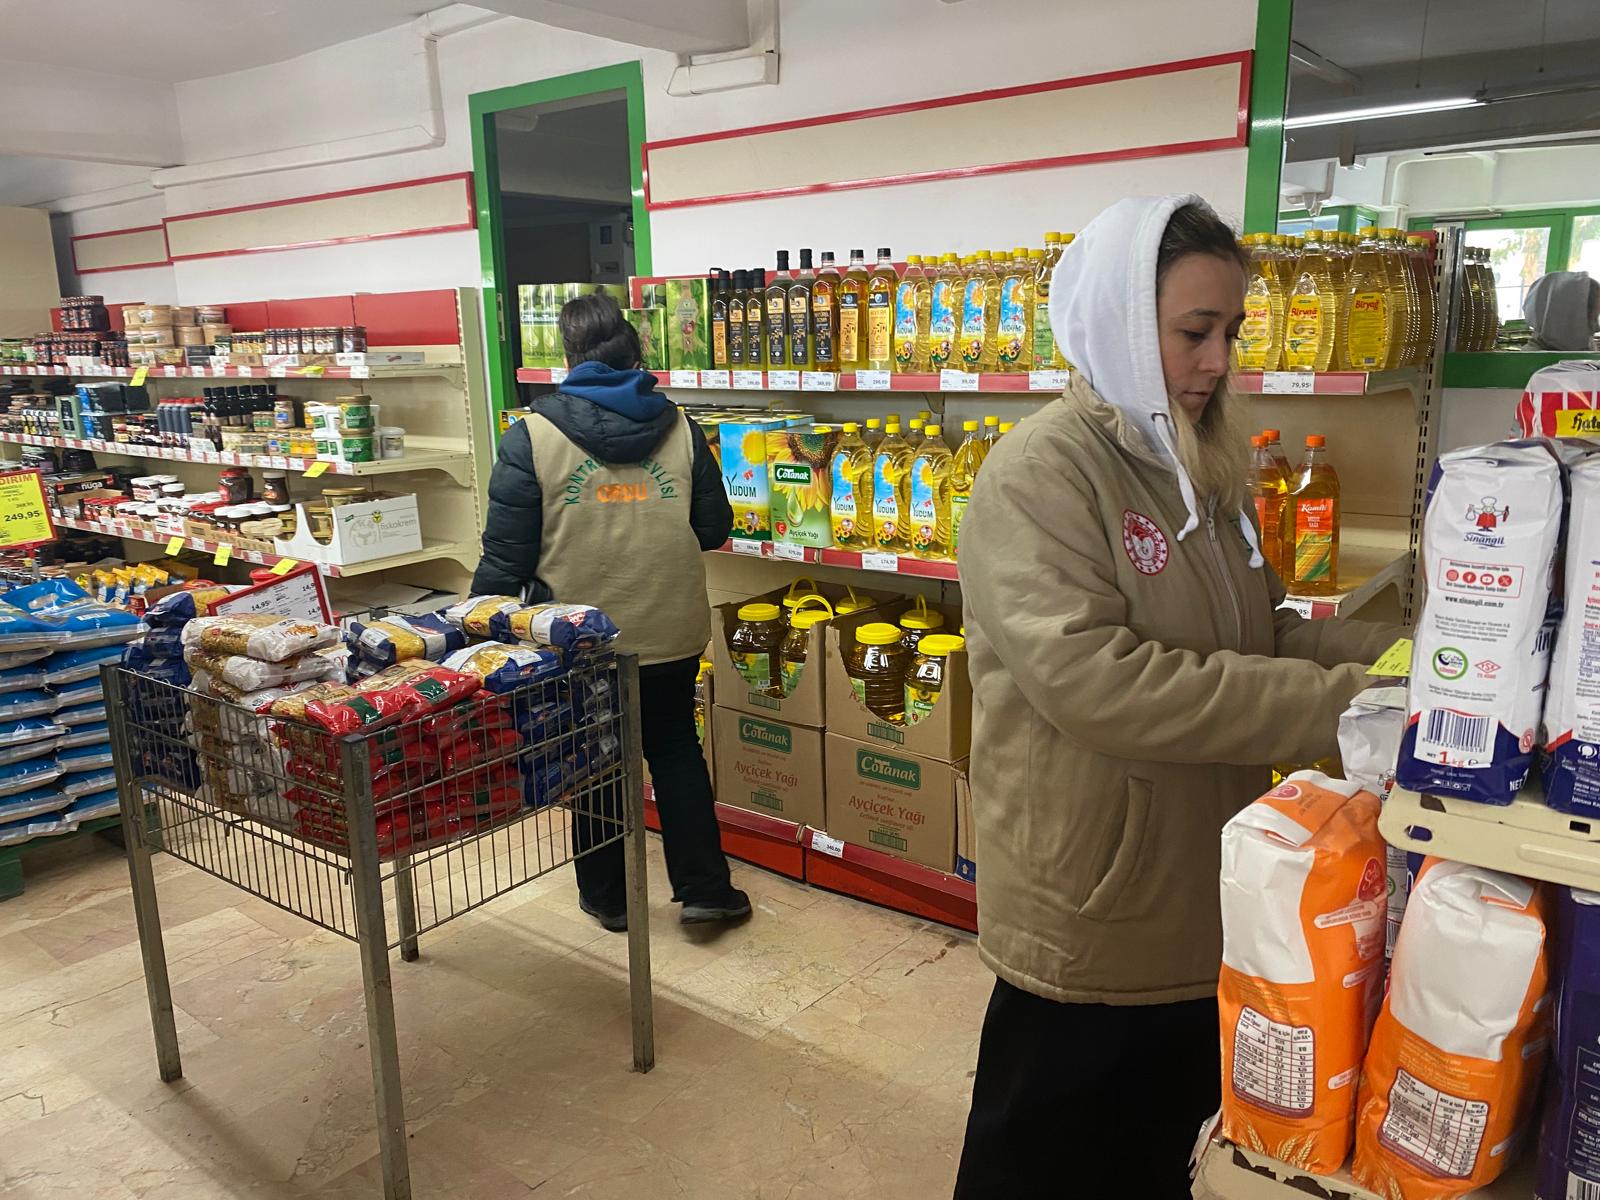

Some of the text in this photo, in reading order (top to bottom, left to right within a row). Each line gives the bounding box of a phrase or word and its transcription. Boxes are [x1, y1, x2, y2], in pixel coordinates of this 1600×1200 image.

[1291, 381, 1310, 389] 79,95
[726, 472, 757, 498] YUDUM
[4, 510, 40, 522] 249,95
[1463, 533, 1505, 546] Sinangil
[1445, 595, 1504, 609] www.sinangil.com.tr
[734, 760, 798, 787] Ayçiçek Yağı
[848, 795, 926, 825] Ayçiçek Yağı
